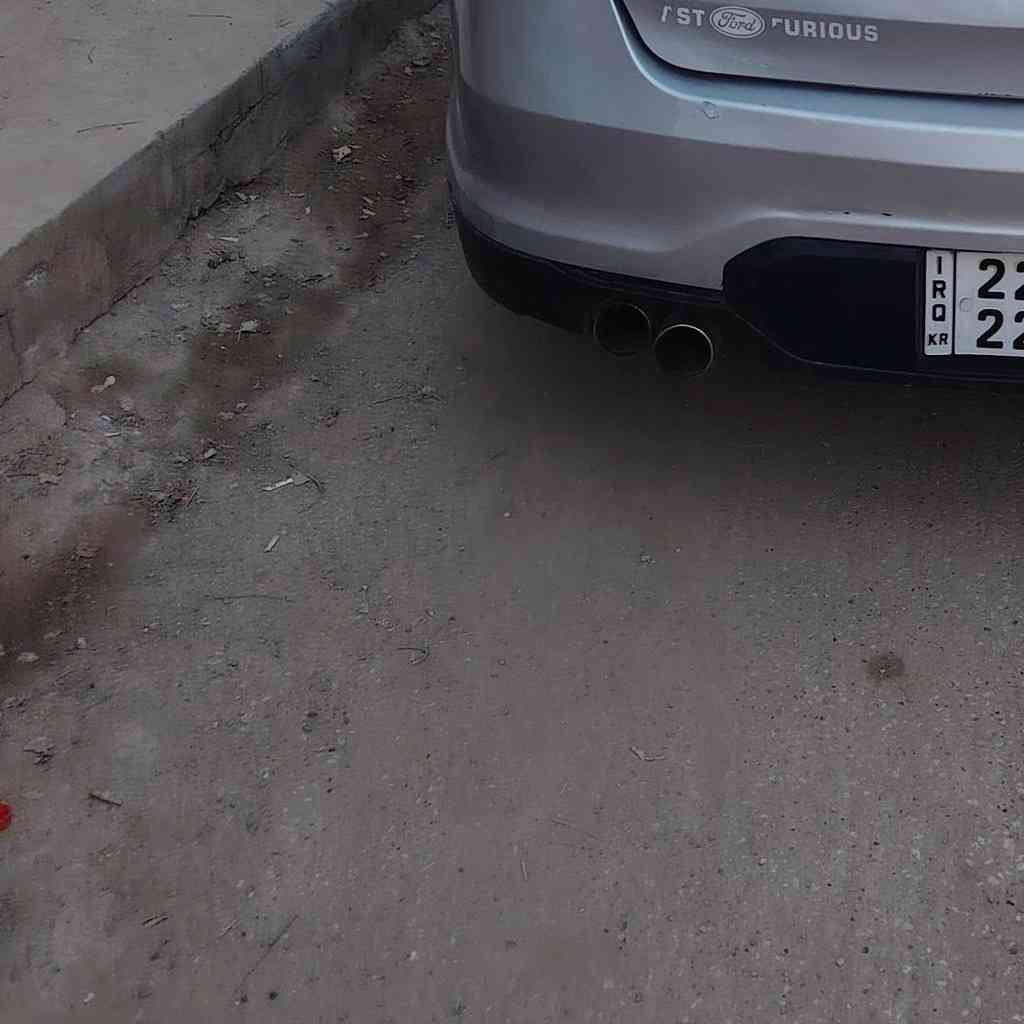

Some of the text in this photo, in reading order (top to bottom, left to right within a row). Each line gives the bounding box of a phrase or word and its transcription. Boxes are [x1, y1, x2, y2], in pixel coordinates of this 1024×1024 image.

[717, 11, 758, 32] Ford
[931, 255, 947, 322] IRQ
[927, 332, 949, 347] KR
